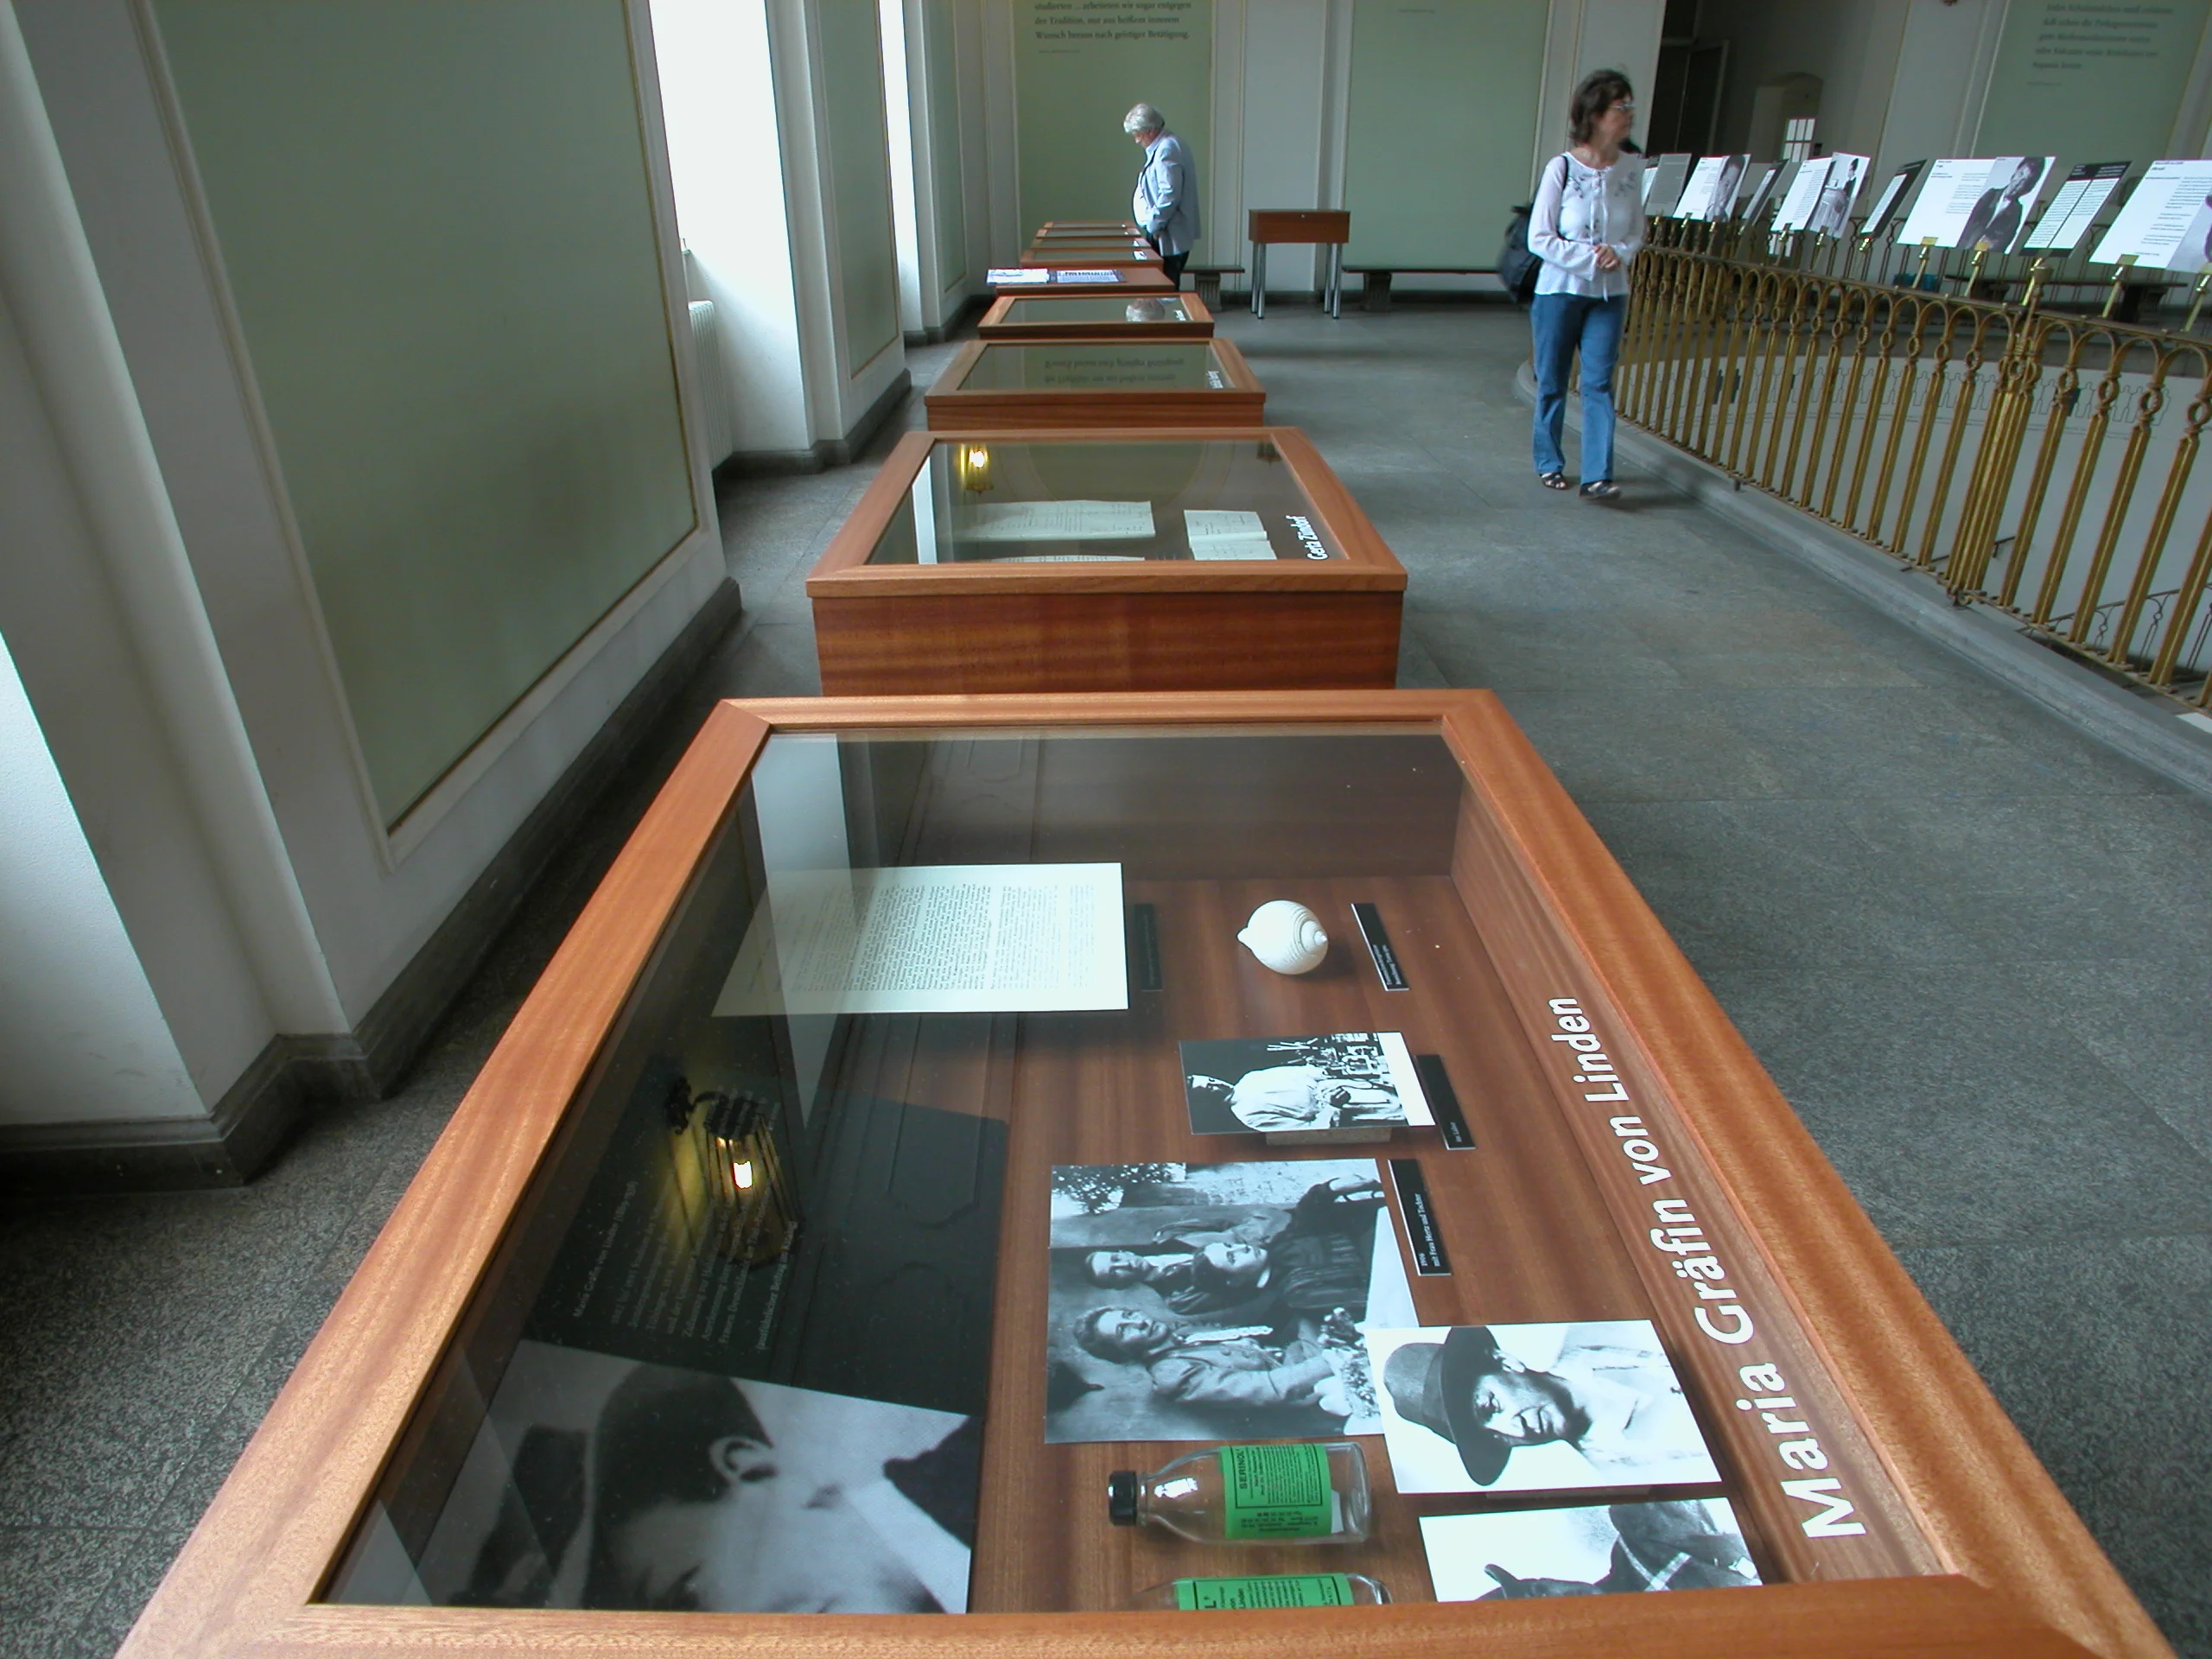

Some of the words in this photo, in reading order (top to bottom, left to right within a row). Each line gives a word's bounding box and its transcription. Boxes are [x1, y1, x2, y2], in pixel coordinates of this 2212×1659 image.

[1548, 997, 1629, 1103] Linden
[1610, 1116, 1671, 1185] von
[1650, 1199, 1753, 1344] Gräfin
[1736, 1363, 1866, 1538] Maria
